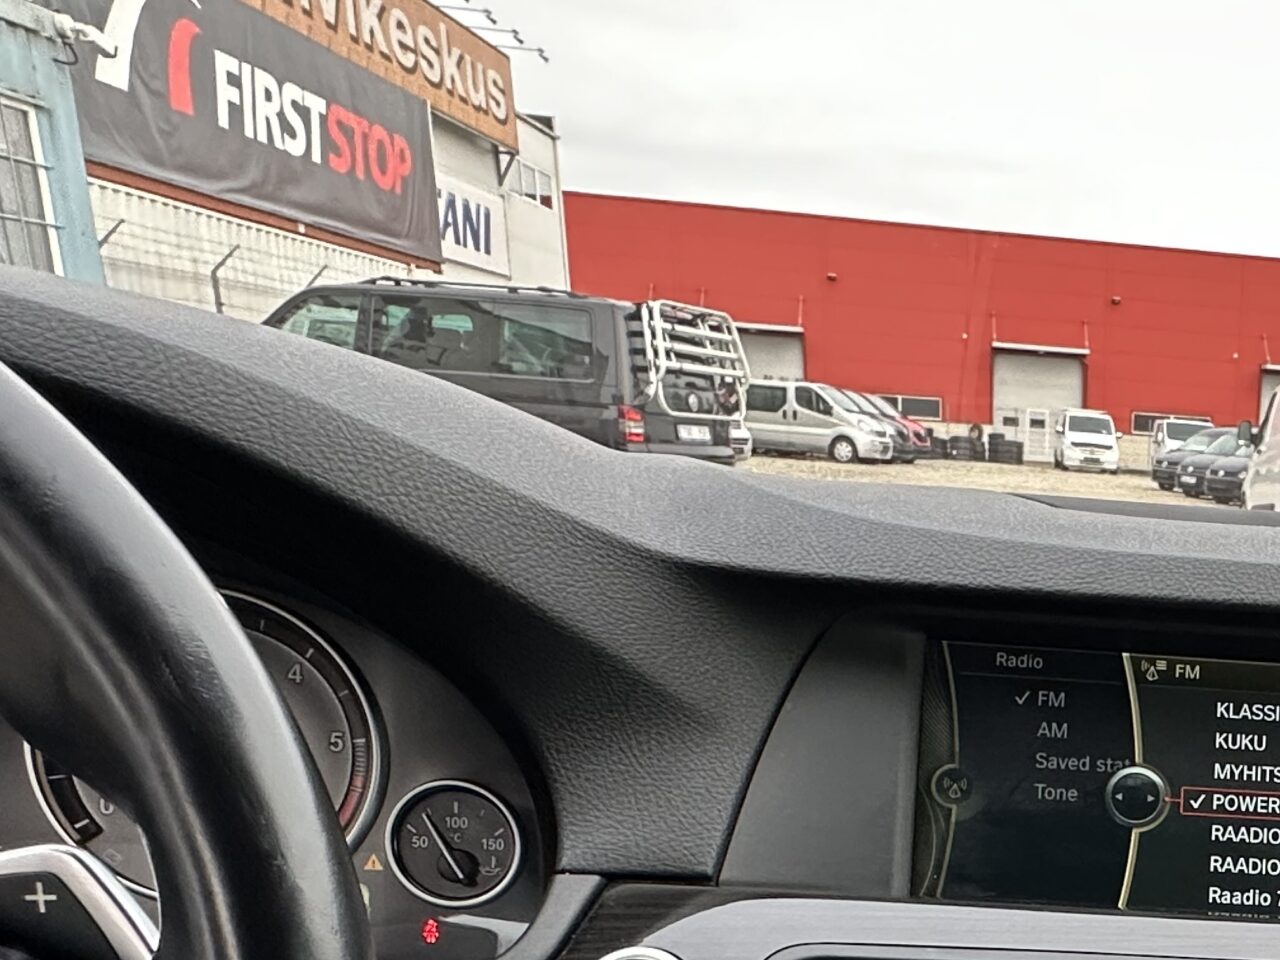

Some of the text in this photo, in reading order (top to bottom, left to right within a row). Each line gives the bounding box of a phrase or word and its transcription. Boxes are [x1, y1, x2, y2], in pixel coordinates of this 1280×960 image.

[437, 188, 492, 256] ANI
[996, 652, 1044, 670] Radio
[287, 663, 303, 683] 4
[1175, 664, 1200, 680] FM
[1037, 690, 1066, 708] FM
[1036, 721, 1068, 739] AM
[329, 732, 345, 752] 5
[1215, 732, 1267, 751] KUKU
[1035, 752, 1090, 771] Saved
[1033, 783, 1079, 801] Tone
[1212, 794, 1280, 814] POWER
[445, 816, 469, 829] 100
[411, 835, 429, 848] 50
[481, 838, 505, 851] 150
[1208, 886, 1272, 907] Raadio
